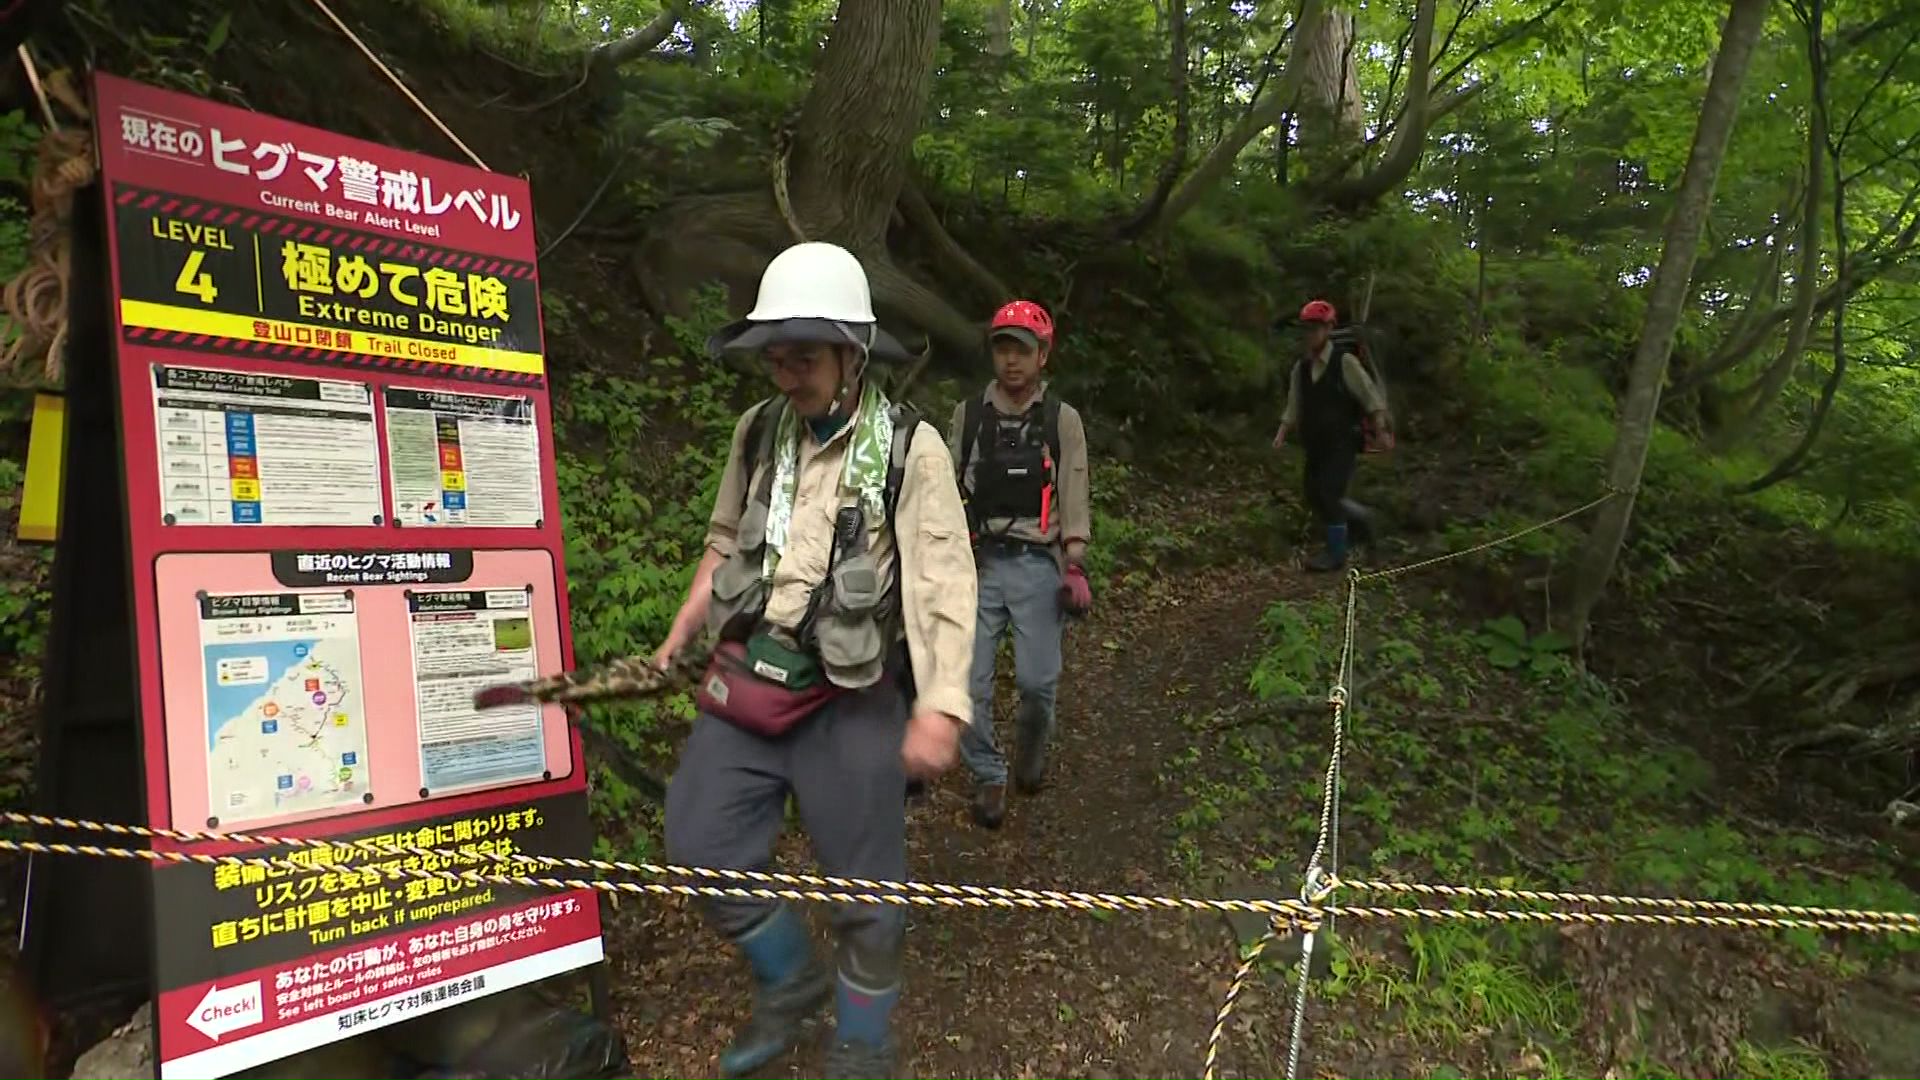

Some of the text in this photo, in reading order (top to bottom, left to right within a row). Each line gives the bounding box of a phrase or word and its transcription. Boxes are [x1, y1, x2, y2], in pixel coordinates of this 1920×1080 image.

[120, 114, 521, 231] 現在の ヒグマ警戒レベル
[152, 216, 234, 251] LEVEL
[260, 190, 440, 238] Current Bear Alert Level
[175, 250, 218, 304] 4
[280, 240, 511, 322] 極めて危険
[252, 321, 457, 361] 登山口閉鎖 Trail Closed
[299, 296, 502, 342] Extreme Danger
[296, 552, 451, 571] 直近のヒグマ活動情報
[326, 571, 428, 582] Recent Bear Sightings
[308, 889, 496, 945] Turn back if unprepared.
[278, 965, 442, 1020] See left board for safety rules
[337, 974, 486, 1031] 知床ヒグマ対策連絡会議
